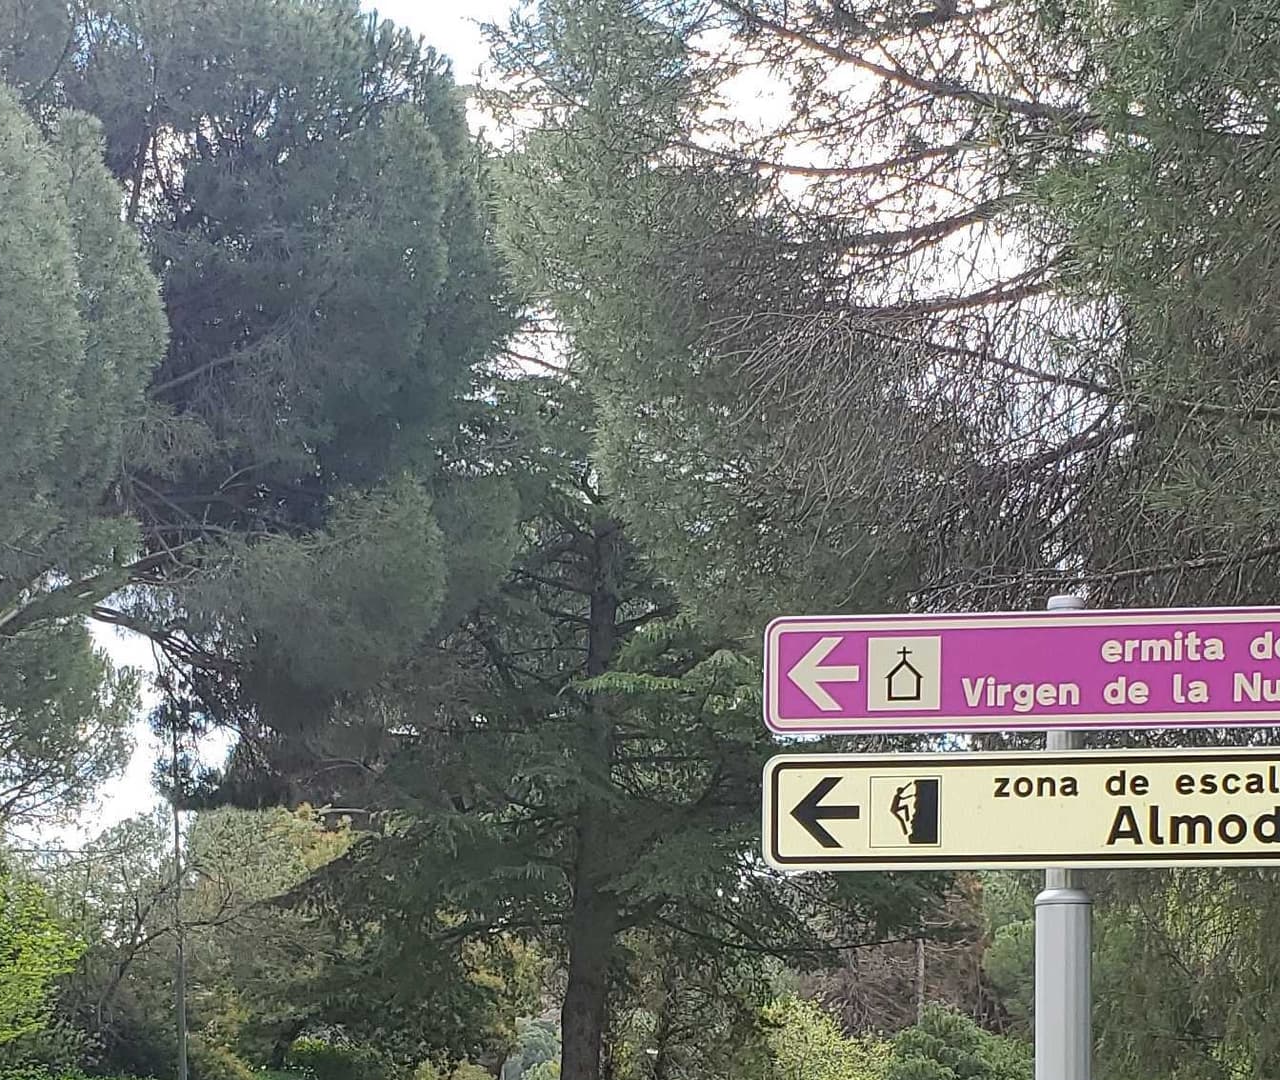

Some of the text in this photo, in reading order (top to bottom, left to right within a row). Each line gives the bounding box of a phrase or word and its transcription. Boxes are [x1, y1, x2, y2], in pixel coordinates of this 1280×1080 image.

[1101, 630, 1224, 662] ermita
[961, 677, 1080, 713] Virgen
[1104, 677, 1149, 704] de
[1173, 674, 1209, 703] la
[994, 776, 1079, 798] zona
[1106, 771, 1149, 796] de
